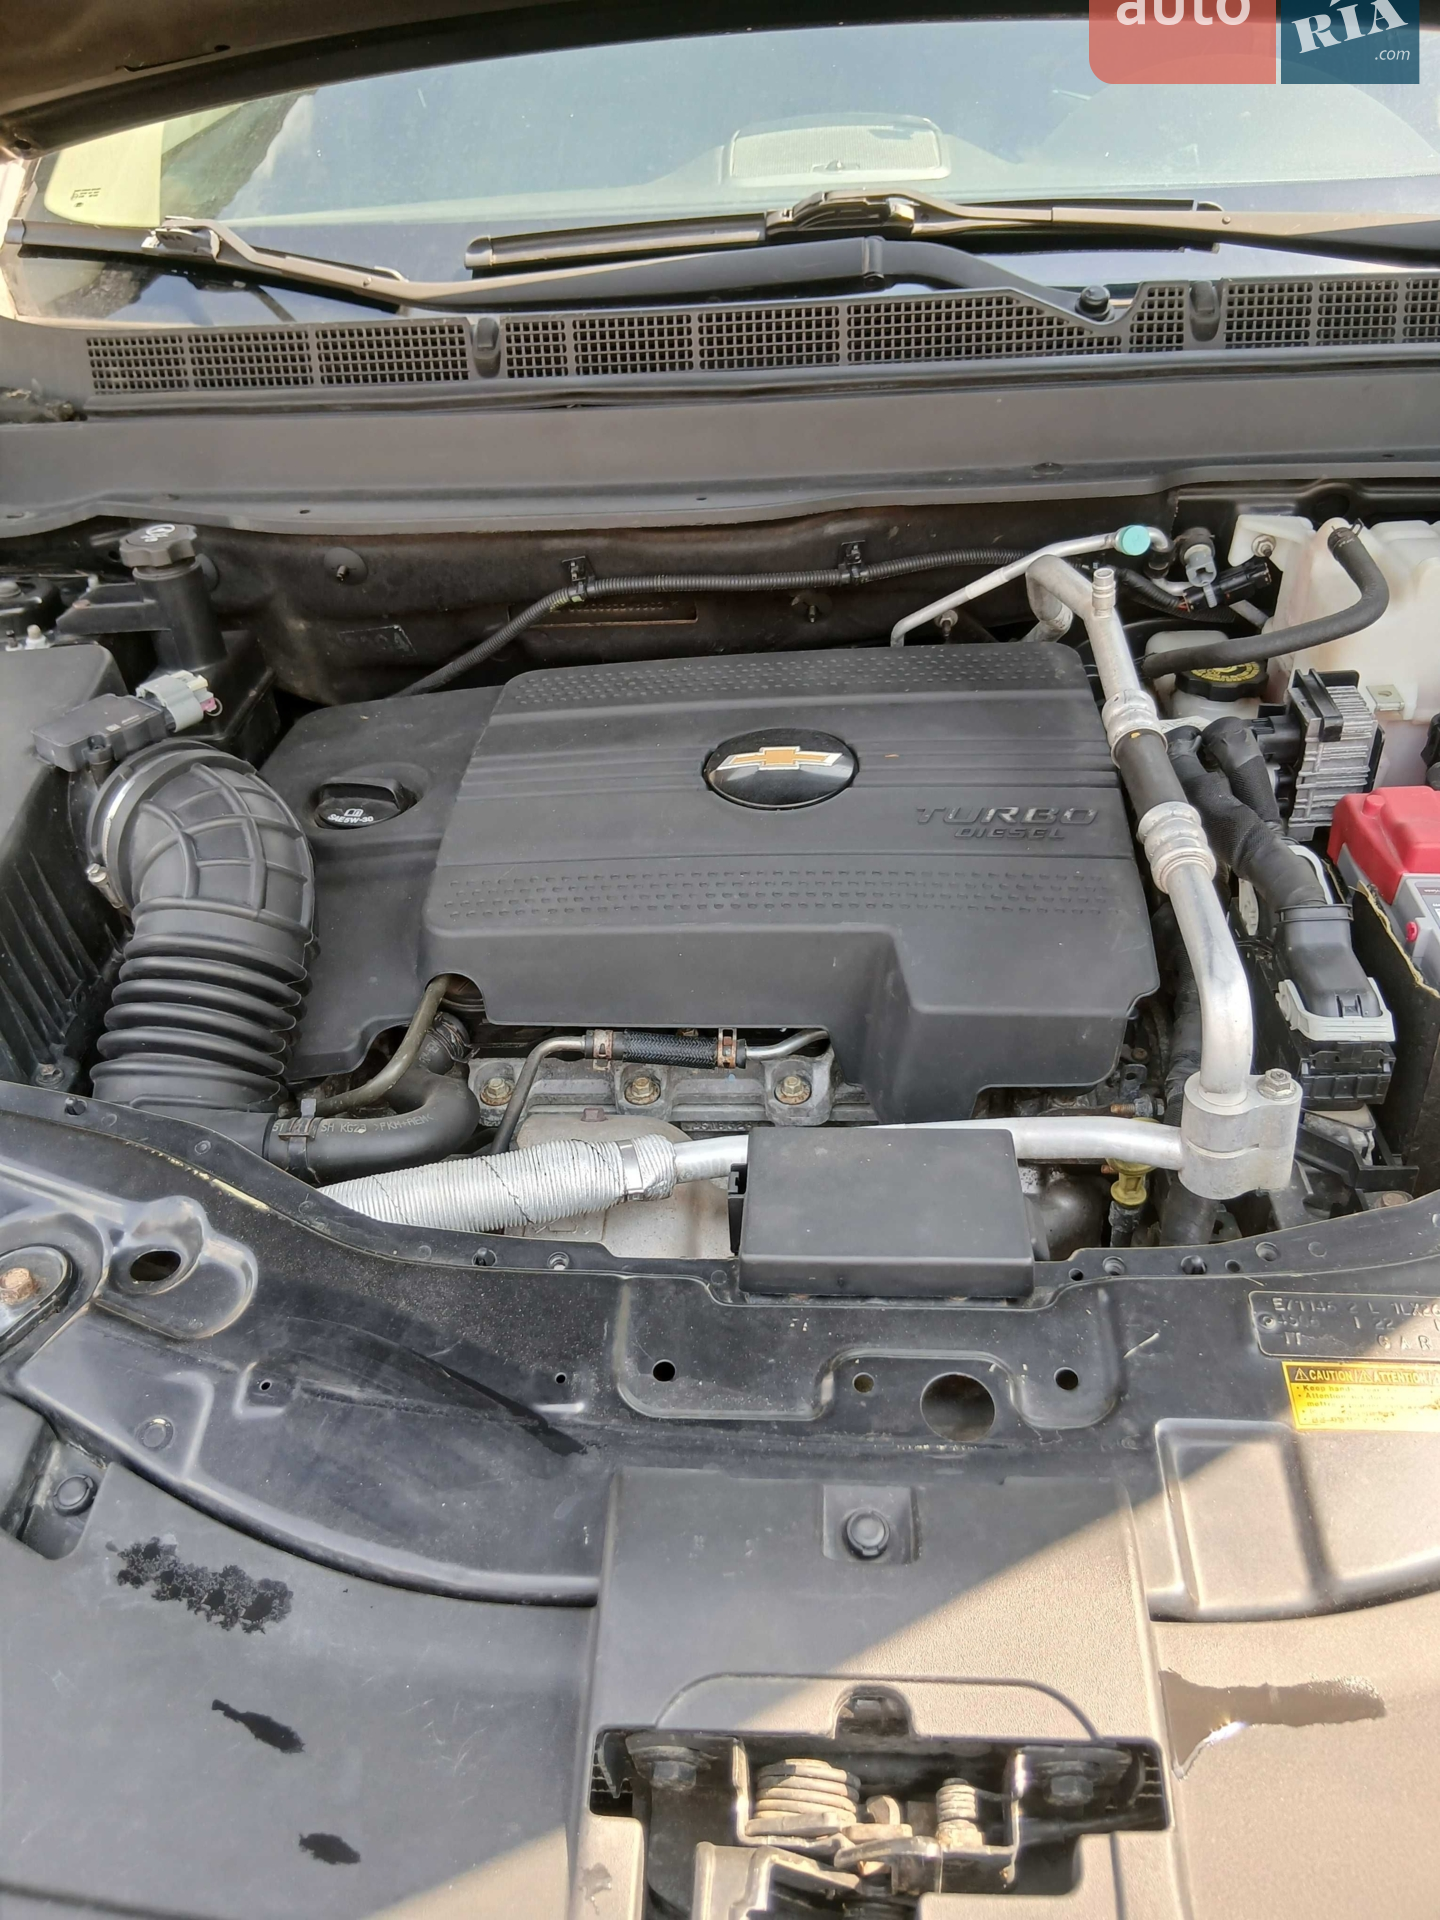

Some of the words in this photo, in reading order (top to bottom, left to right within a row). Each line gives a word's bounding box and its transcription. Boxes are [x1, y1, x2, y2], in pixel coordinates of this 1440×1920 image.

[327, 813, 345, 823] SAE
[916, 806, 1099, 826] TURBO
[954, 827, 1066, 841] DIESEL
[1309, 1369, 1354, 1382] CAUTION
[1373, 1370, 1430, 1384] ATTENTION
